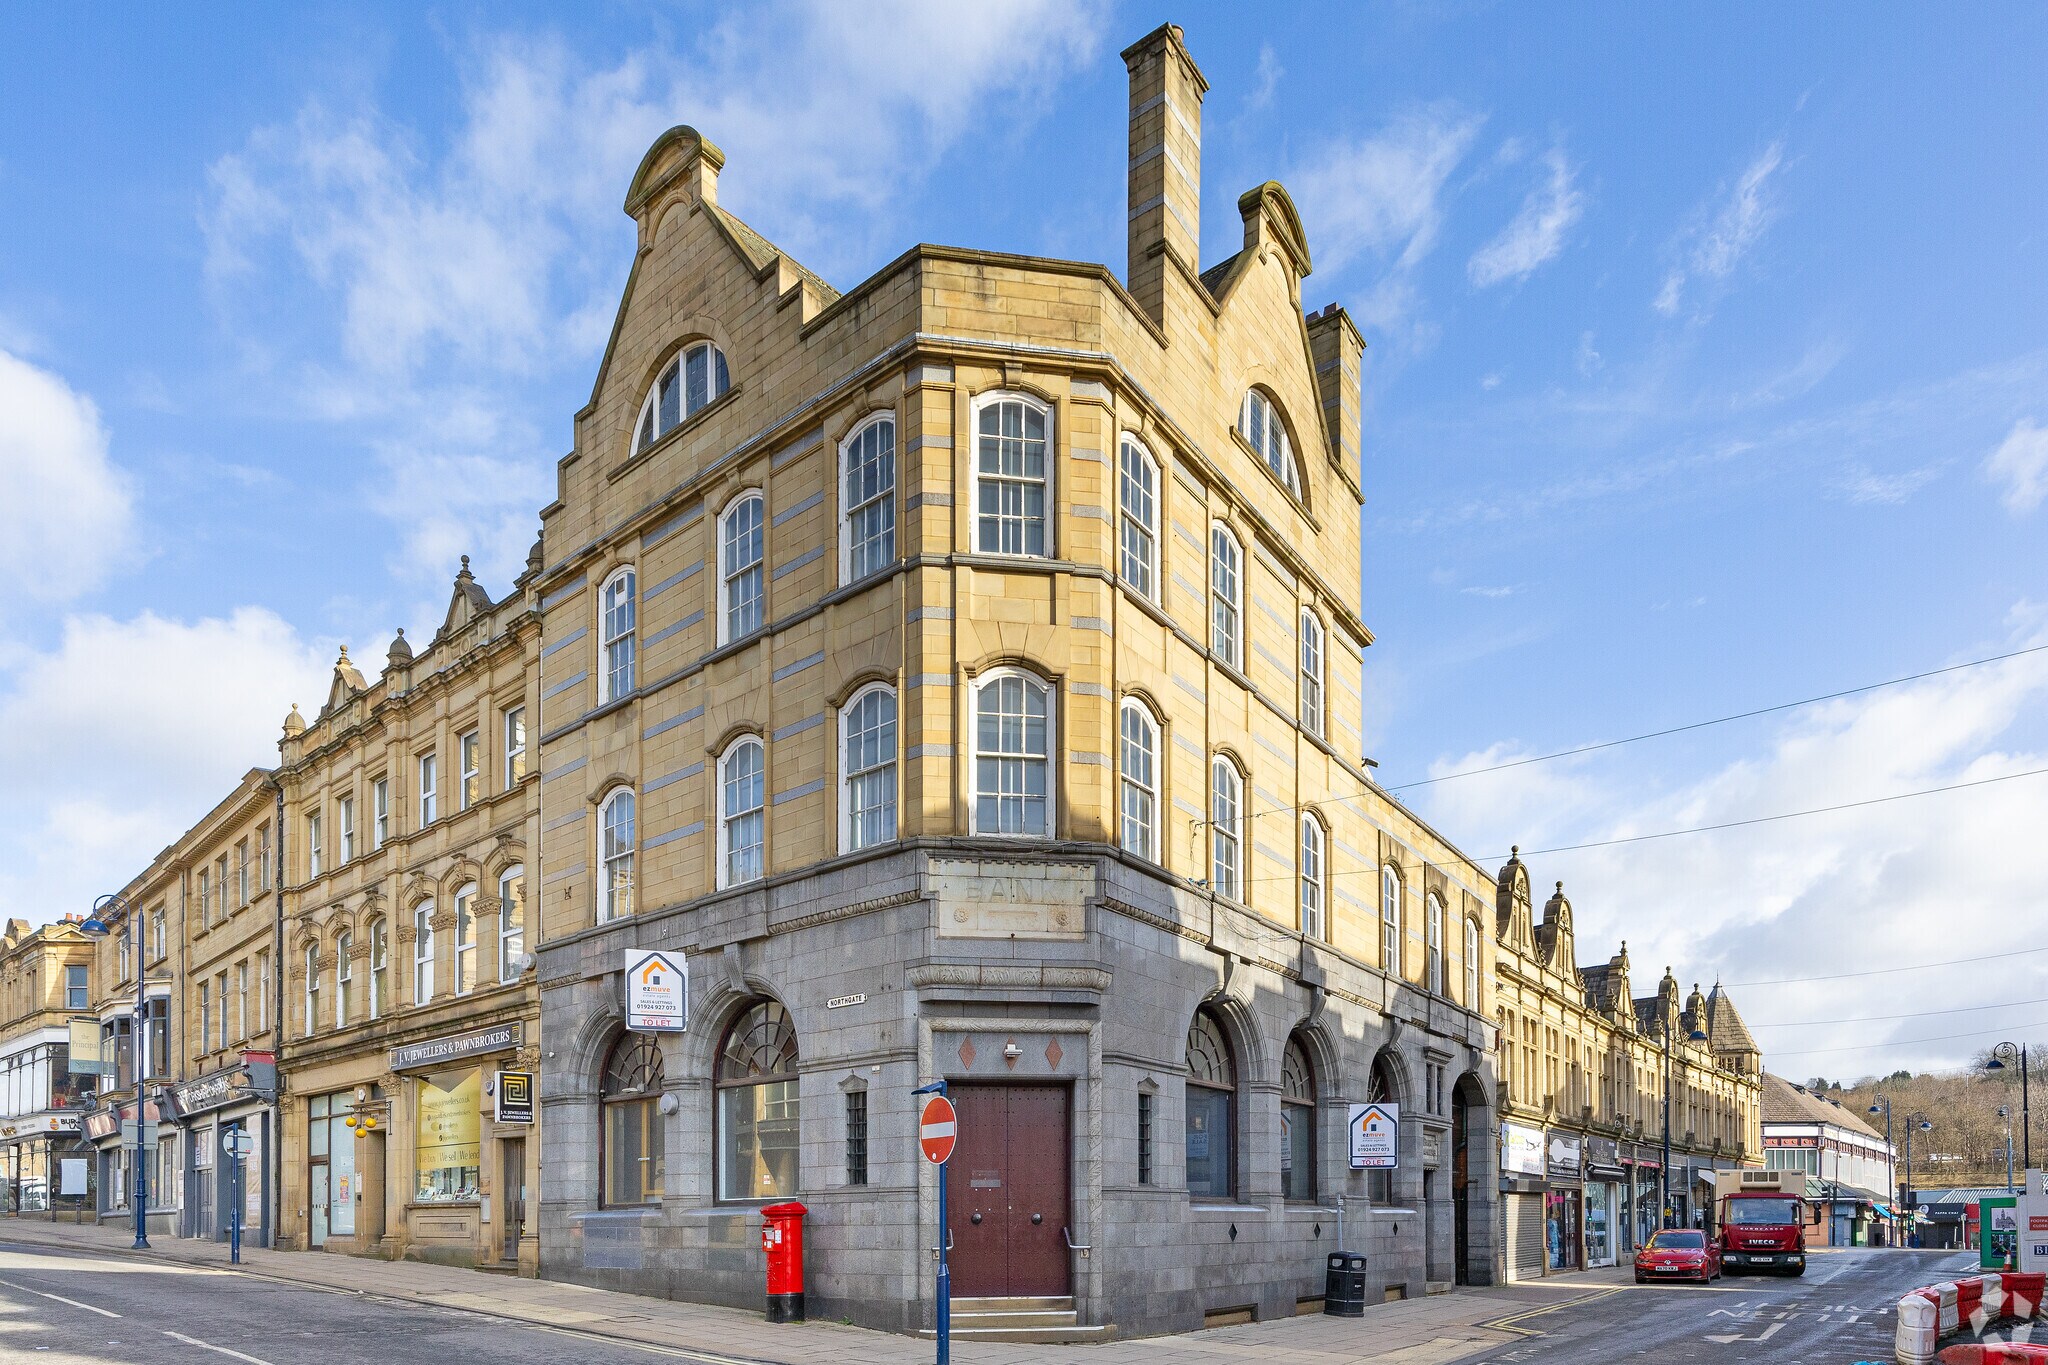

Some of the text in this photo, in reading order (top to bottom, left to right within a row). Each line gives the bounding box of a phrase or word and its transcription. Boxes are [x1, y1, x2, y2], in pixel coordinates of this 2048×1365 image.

[967, 877, 1063, 904] BANK
[830, 994, 862, 1006] NORTHGATE
[72, 1041, 99, 1051] Principal
[410, 1043, 448, 1064] JEWELLERS
[448, 1042, 454, 1054] &
[454, 1030, 510, 1053] PAWNBROKERS
[448, 1151, 457, 1161] sell
[460, 1150, 468, 1160] We
[468, 1149, 480, 1160] lend
